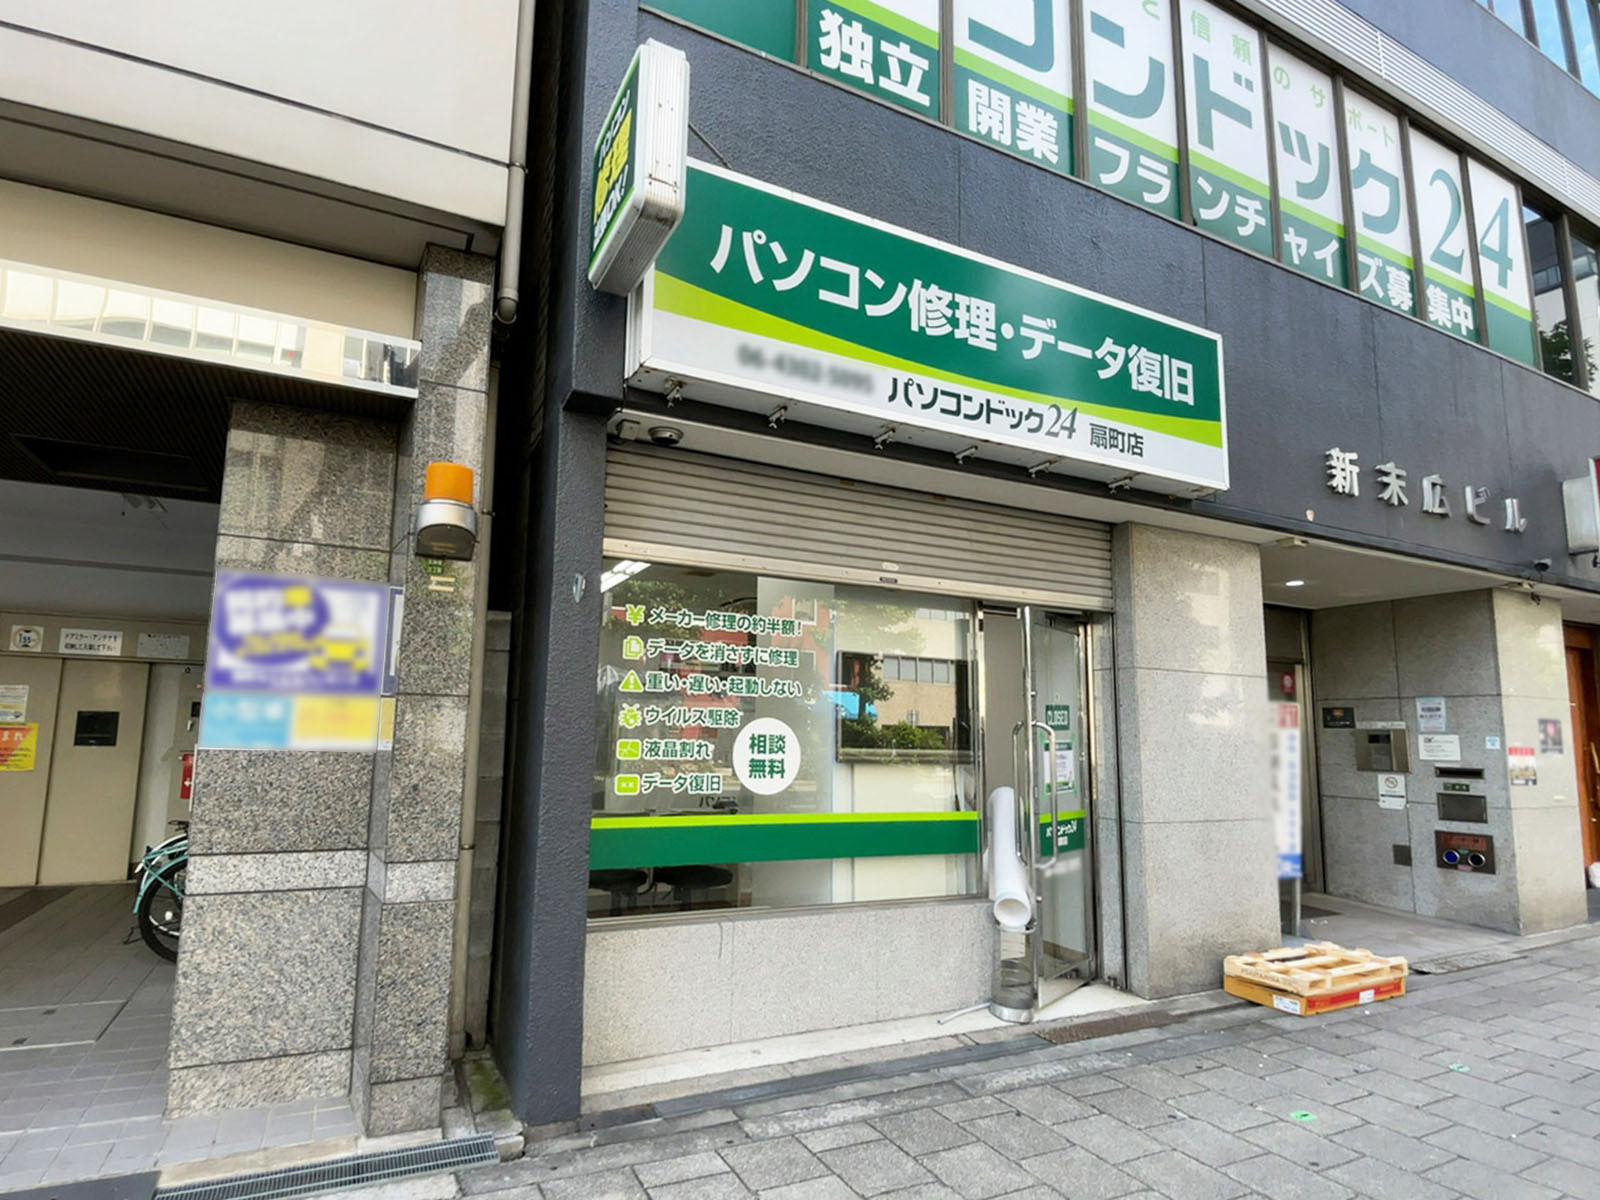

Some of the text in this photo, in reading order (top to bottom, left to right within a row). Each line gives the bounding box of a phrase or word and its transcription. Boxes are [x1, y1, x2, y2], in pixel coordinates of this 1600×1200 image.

[710, 224, 1195, 406] パソコン修理・データ復旧
[888, 376, 1078, 440] パソコンドック24
[1089, 422, 1145, 458] 扇町店
[1325, 447, 1528, 533] 新末広ビル
[648, 639, 799, 667] データを消さずに修理
[644, 706, 741, 727] ウイルス駆除
[643, 740, 712, 759] 液晶割れ
[749, 733, 786, 755] 相談
[749, 758, 786, 779] 無料
[641, 774, 723, 794] データ復旧
